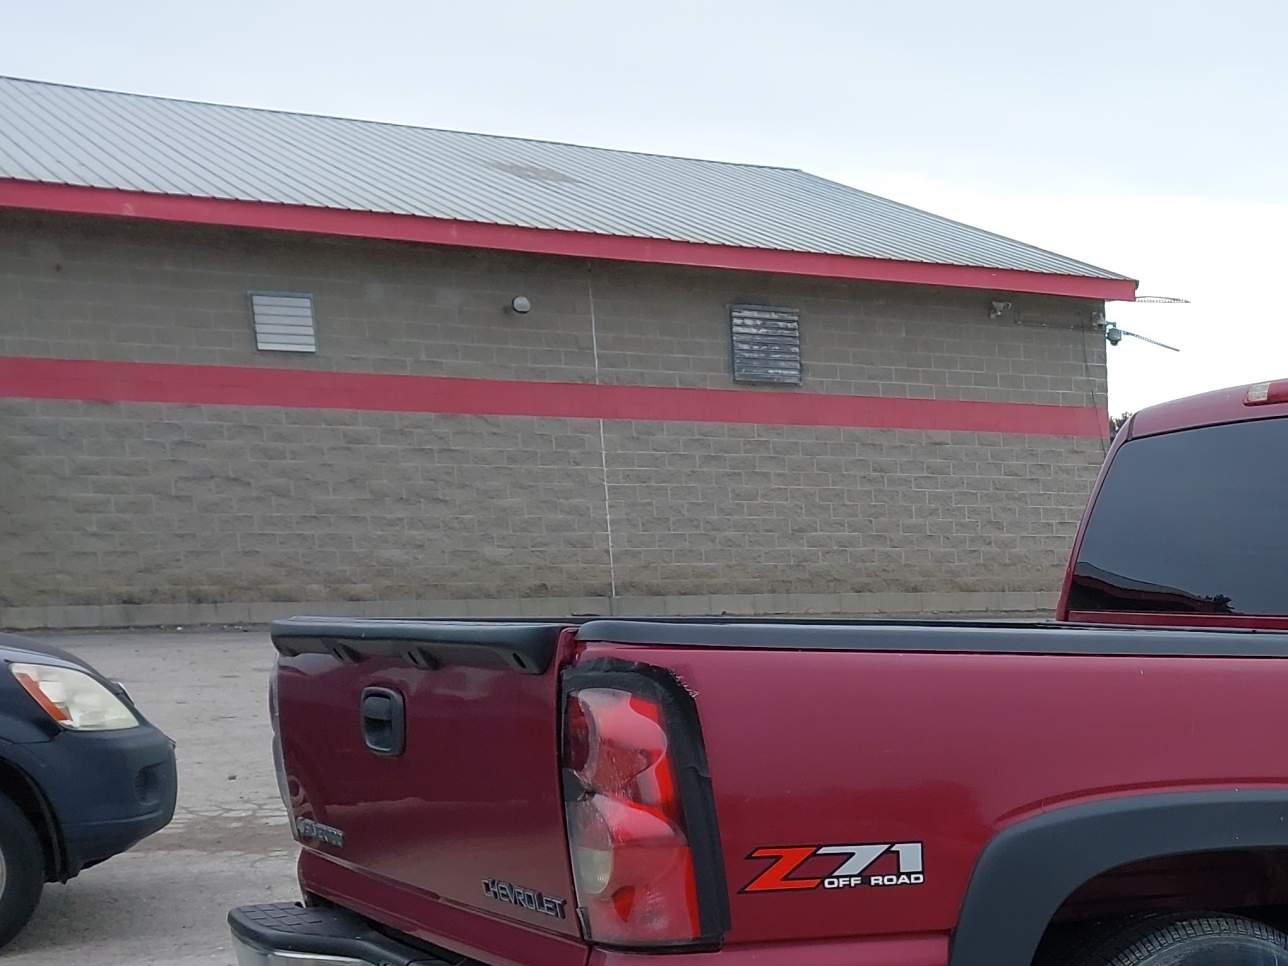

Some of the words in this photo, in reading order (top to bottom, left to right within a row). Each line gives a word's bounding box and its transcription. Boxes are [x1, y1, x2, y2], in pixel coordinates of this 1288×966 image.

[738, 842, 923, 894] Z71
[823, 877, 862, 889] OFF
[870, 873, 924, 887] ROAD
[481, 878, 567, 919] CHEVROLET
